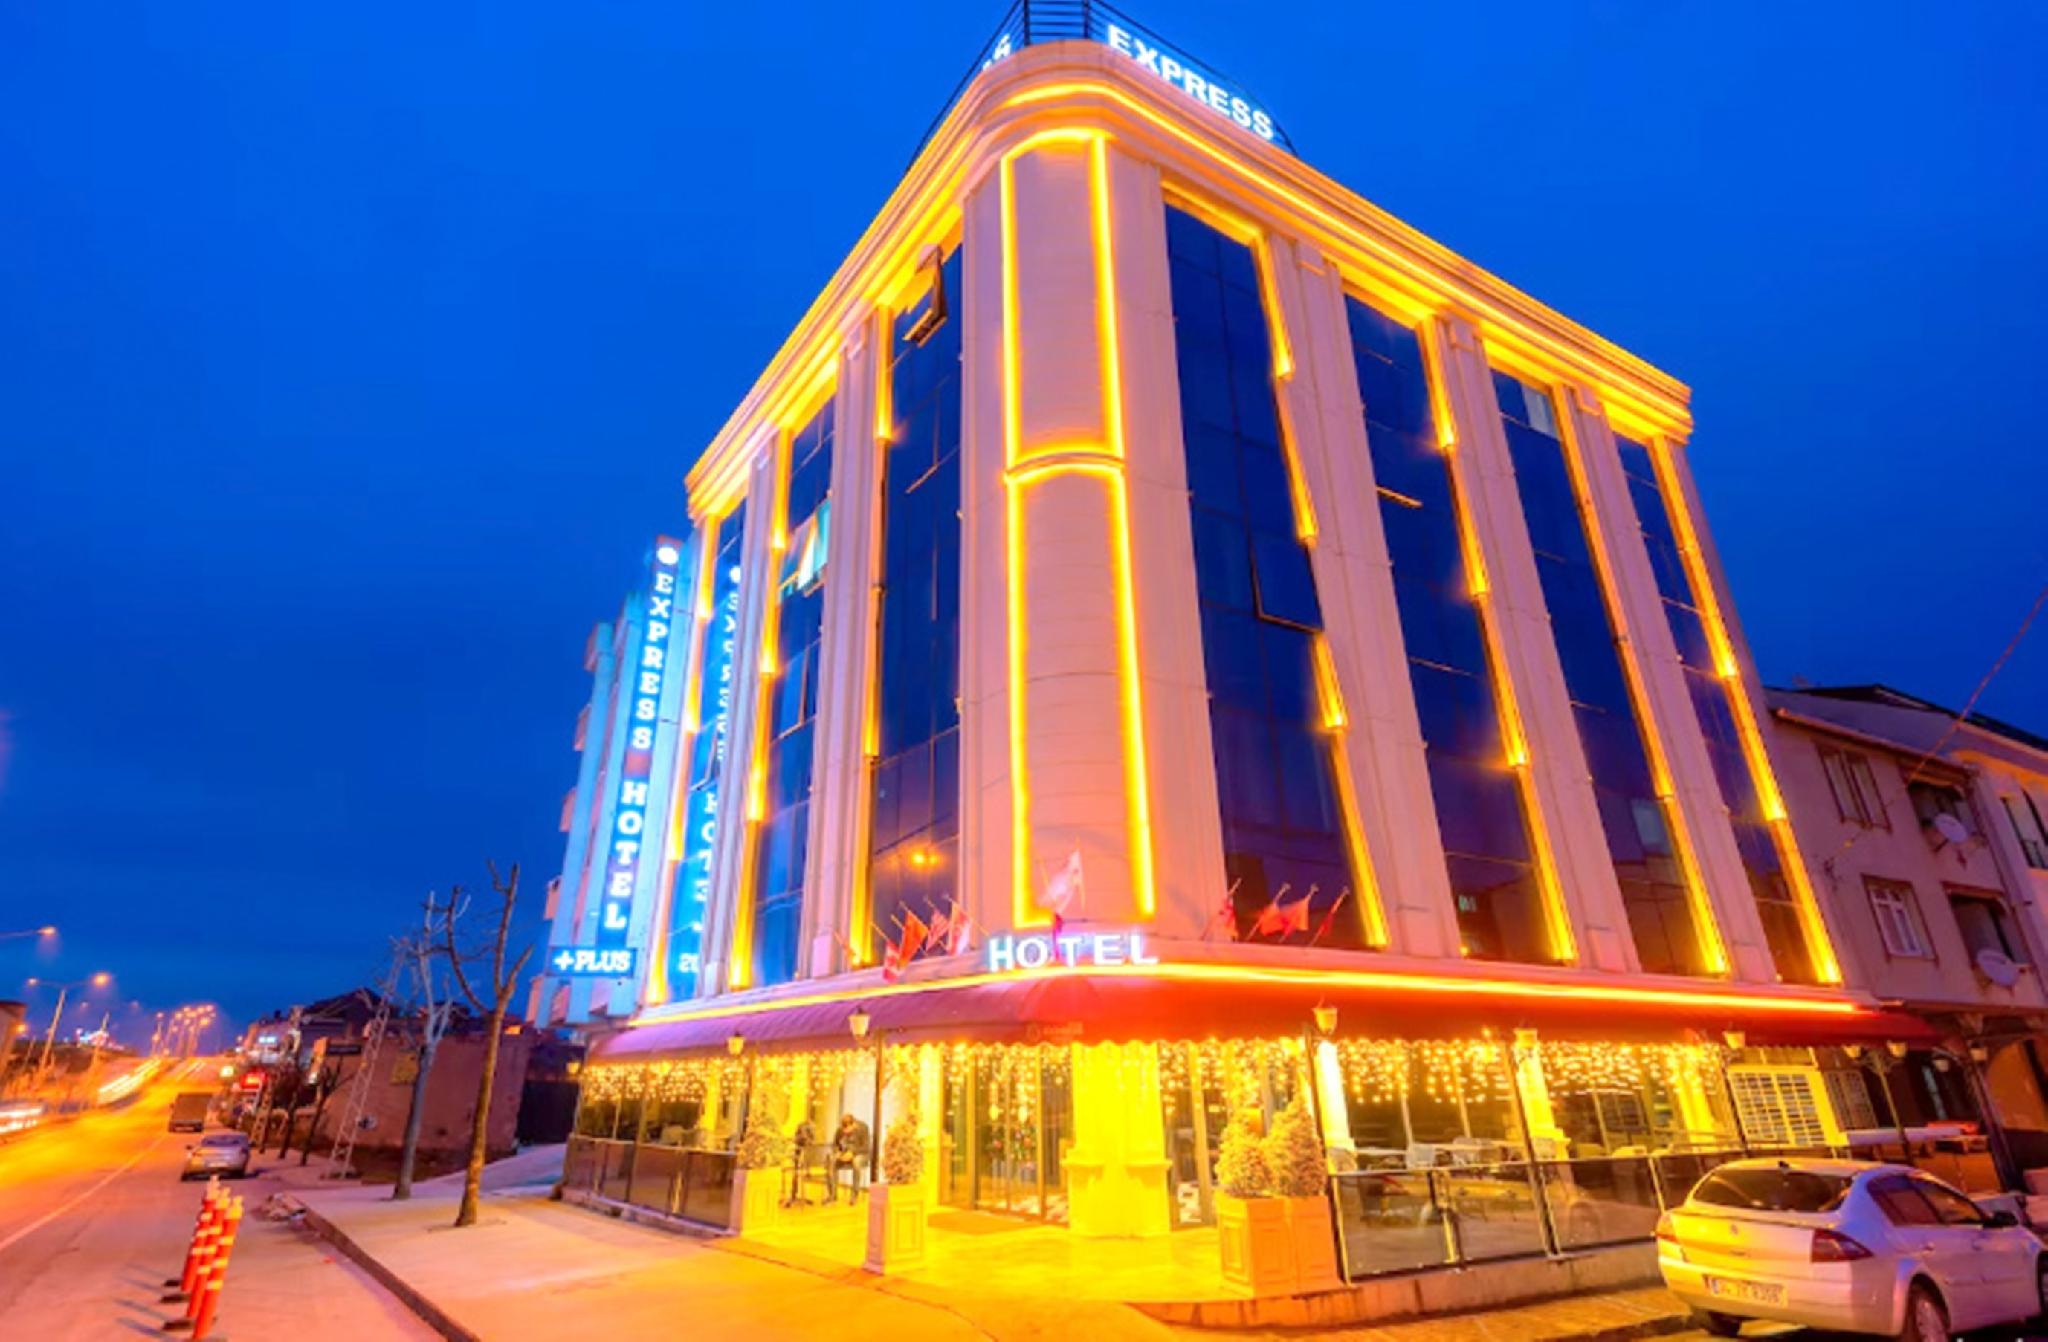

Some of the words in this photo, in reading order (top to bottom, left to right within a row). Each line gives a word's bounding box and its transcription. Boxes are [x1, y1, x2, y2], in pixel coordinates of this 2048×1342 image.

[1108, 24, 1274, 139] EXPRESS
[632, 572, 674, 750] EXPRESS
[605, 780, 647, 930] HOTEL
[988, 932, 1158, 972] HOTEL
